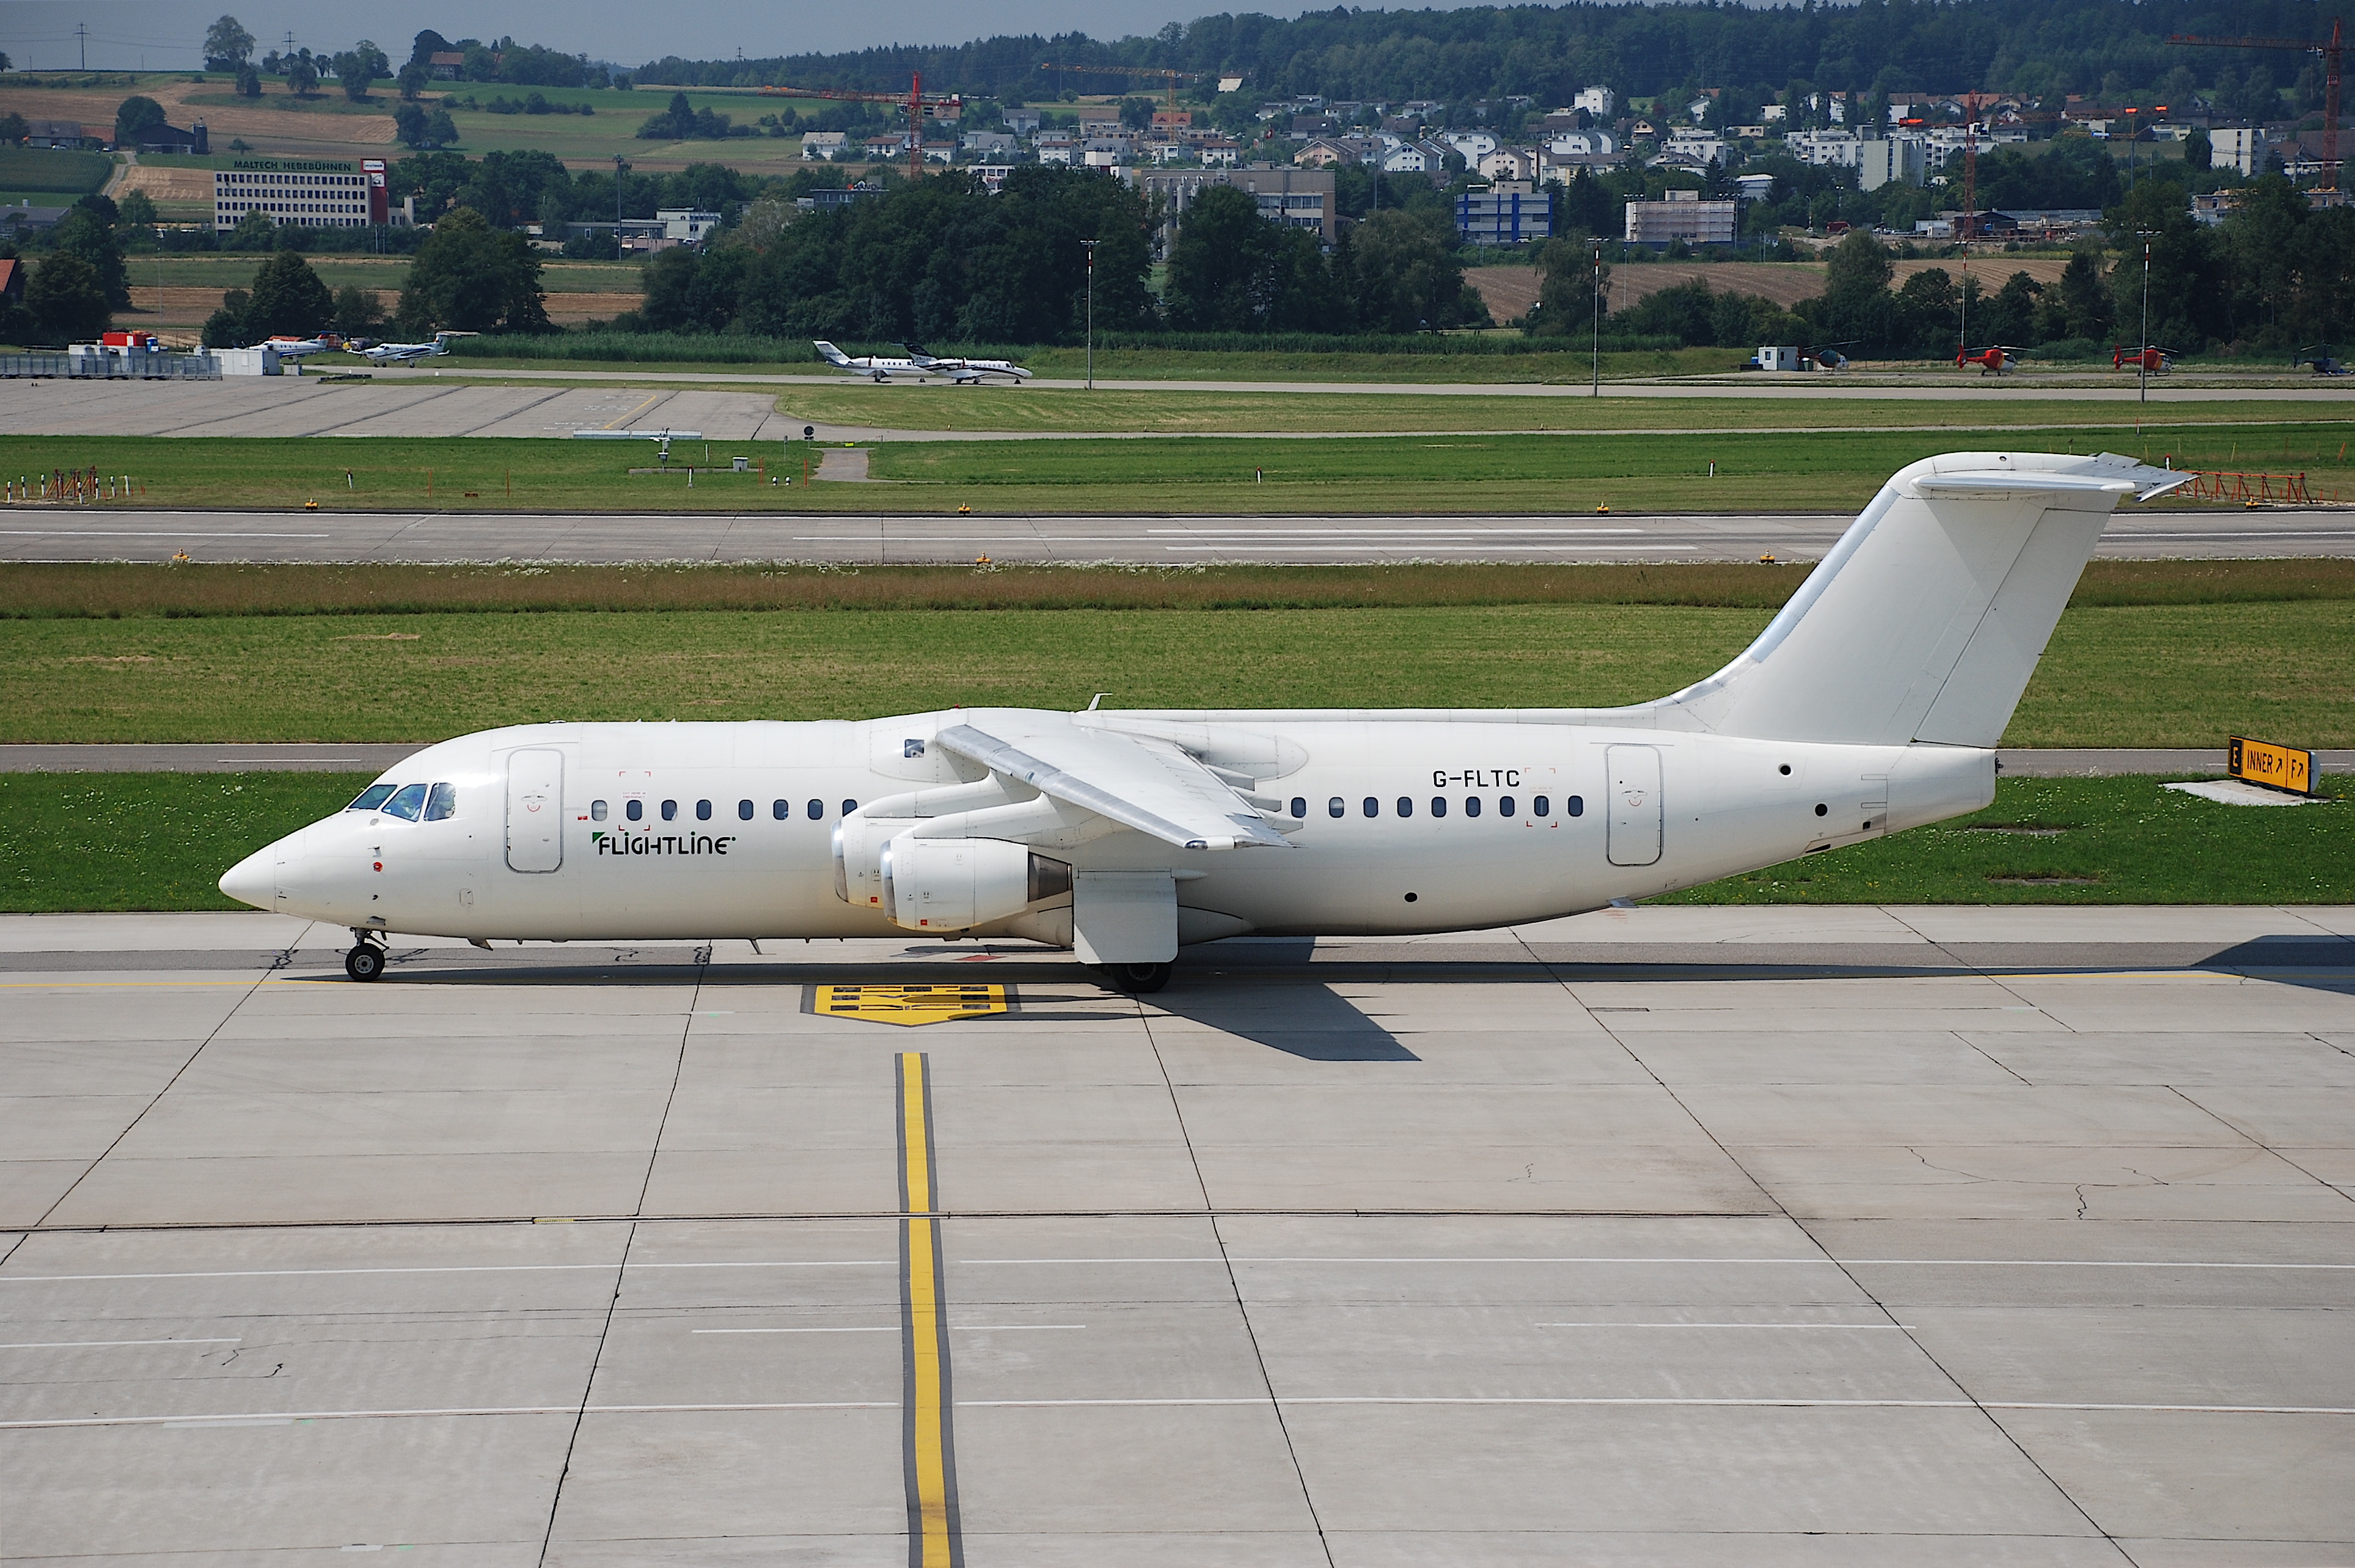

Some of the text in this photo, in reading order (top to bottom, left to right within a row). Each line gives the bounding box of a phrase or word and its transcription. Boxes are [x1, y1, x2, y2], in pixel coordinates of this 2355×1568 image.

[284, 162, 351, 171] HEBEBÜHNEN
[2233, 746, 2297, 779] E INNER F
[1433, 770, 1520, 788] G-FLTC
